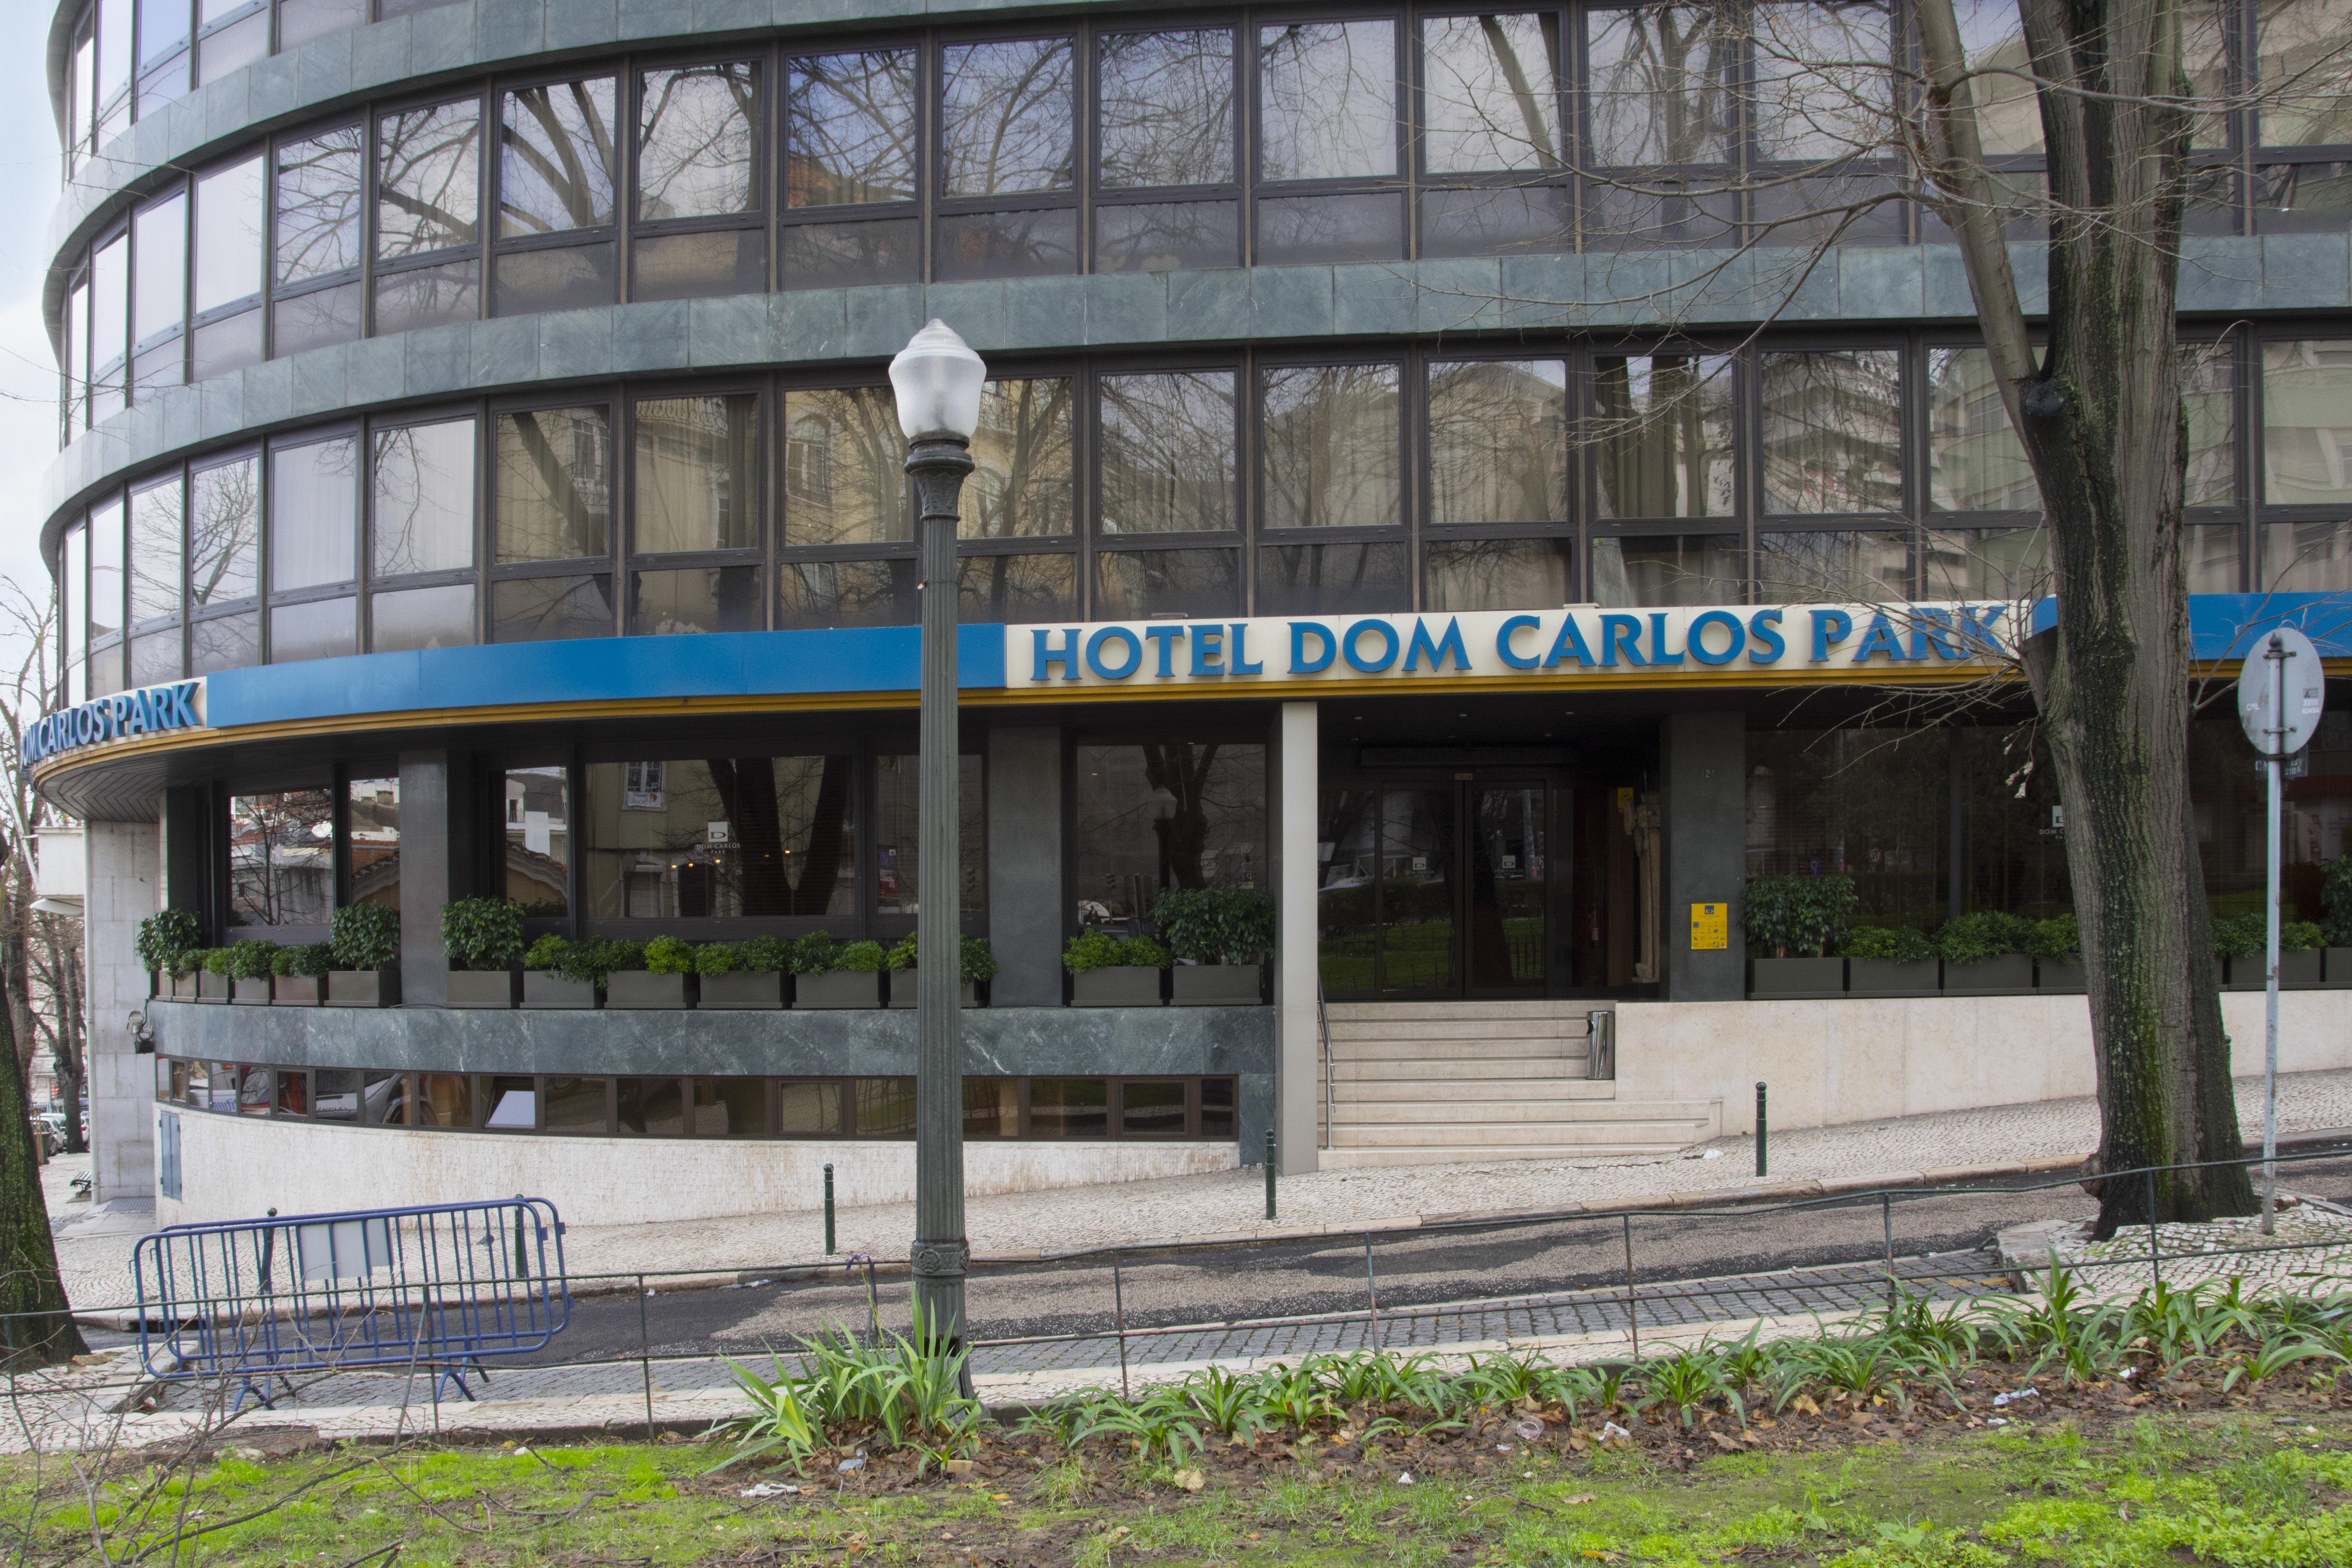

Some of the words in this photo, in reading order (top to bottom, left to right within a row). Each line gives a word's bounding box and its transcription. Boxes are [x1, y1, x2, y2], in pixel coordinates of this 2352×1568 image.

[1030, 623, 1263, 680] HOTEL
[1288, 615, 1473, 674] DOM
[1496, 610, 1786, 669] CARLOS
[1808, 606, 2016, 662] PARK
[39, 699, 113, 757] CARLOS
[112, 682, 201, 738] PARK
